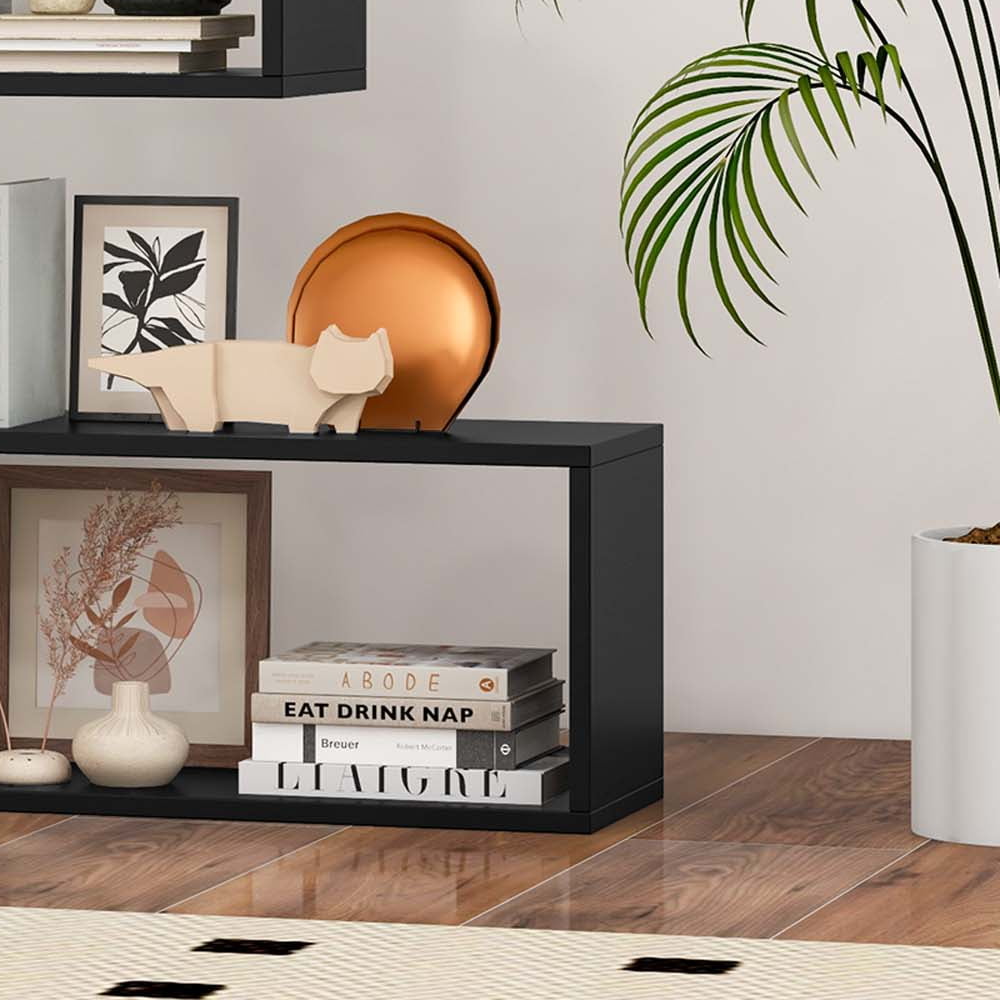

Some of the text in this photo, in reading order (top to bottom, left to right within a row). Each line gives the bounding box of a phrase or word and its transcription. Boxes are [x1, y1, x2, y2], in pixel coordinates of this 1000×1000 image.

[341, 671, 441, 692] ABODE
[284, 701, 329, 718] EAT
[338, 703, 415, 721] DRINK
[423, 706, 474, 723] NAP
[321, 738, 359, 750] Breuer
[396, 742, 420, 751] Robert
